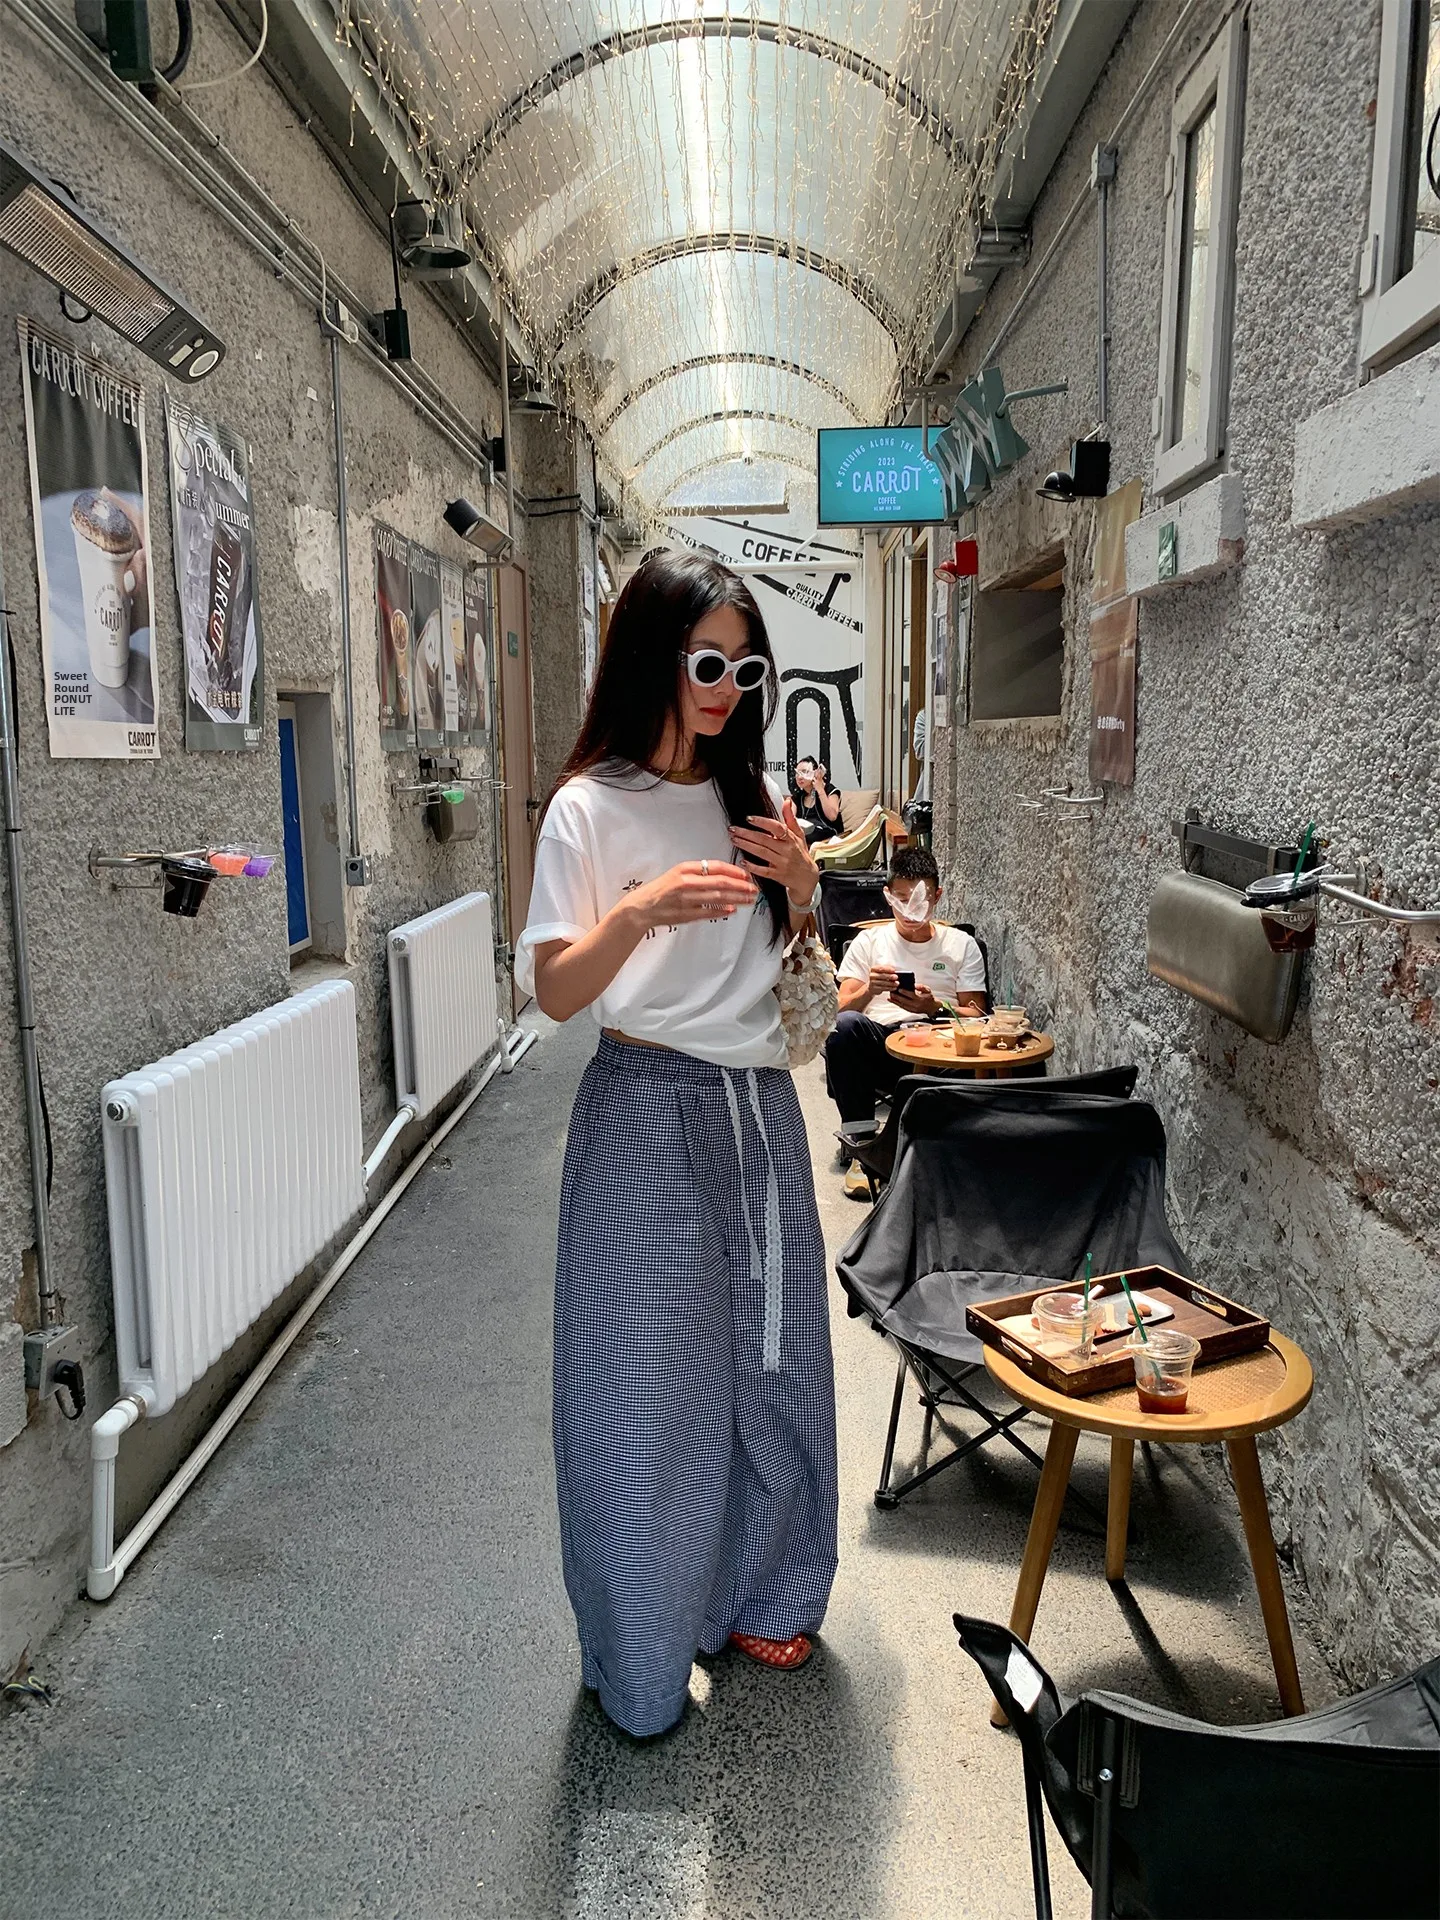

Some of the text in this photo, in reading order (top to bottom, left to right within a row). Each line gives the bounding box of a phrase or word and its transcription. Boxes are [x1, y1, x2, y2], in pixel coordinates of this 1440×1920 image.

[32, 335, 138, 428] CARROT COFFEE
[838, 444, 866, 477] STRIDING
[870, 438, 895, 449] ALONG
[900, 440, 914, 453] THE
[878, 457, 895, 466] 2023
[852, 465, 922, 494] CARROT
[877, 496, 897, 505] COFFEE
[796, 582, 825, 601] QUALITY
[211, 555, 232, 660] CARROT
[785, 588, 857, 630] CARROT OFFEE
[54, 671, 88, 681] Sweet
[54, 683, 89, 693] Round
[54, 694, 92, 704] PONUT
[54, 706, 75, 716] LITE
[127, 731, 156, 747] CARROT
